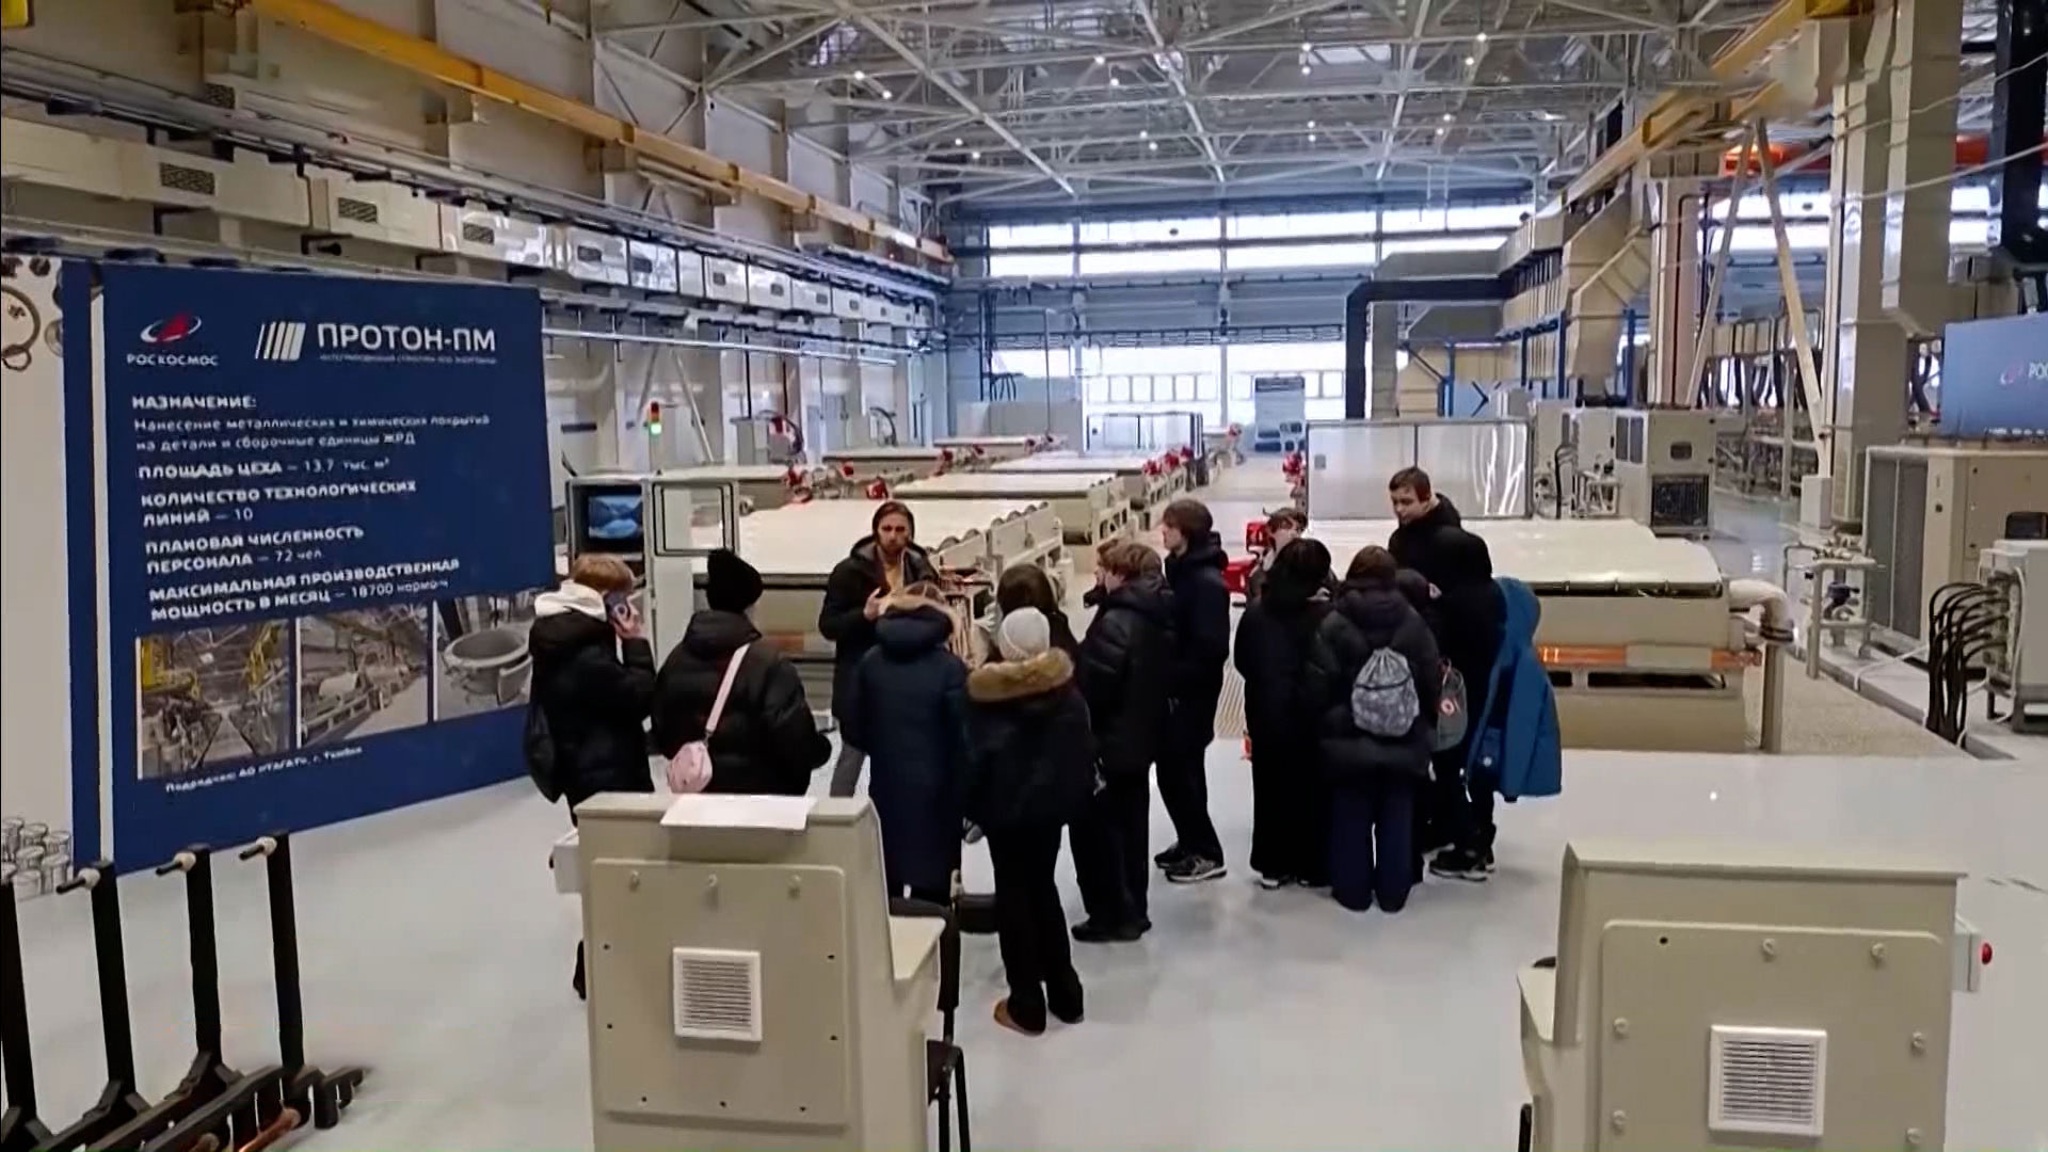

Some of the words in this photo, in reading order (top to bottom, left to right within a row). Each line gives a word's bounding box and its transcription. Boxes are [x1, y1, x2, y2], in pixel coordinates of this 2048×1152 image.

[317, 323, 496, 351] ПРОТОН-ПМ
[127, 353, 219, 366] РОСКОСМОС
[132, 395, 256, 410] НАЗНАЧЕНИЕ:
[134, 418, 221, 432] Нанесение
[226, 417, 335, 430] металлических
[339, 418, 348, 426] и
[352, 416, 428, 427] химических
[430, 414, 490, 429] покрытий
[136, 440, 155, 451] на
[160, 438, 216, 453] детали
[221, 440, 230, 449] и
[235, 435, 314, 450] сборочные
[318, 434, 380, 447] единицы
[383, 431, 416, 445] ЖРД
[138, 463, 234, 479] ПЛОЩАДЬ
[238, 461, 283, 476] ЦЕХА
[140, 488, 260, 508] КОЛИЧЕСТВО
[264, 480, 417, 500] ТЕХНОЛОГИЧЕСКИХ
[143, 507, 211, 527] ЛИНИЙ
[234, 507, 253, 521] 10
[145, 534, 244, 555] ПЛАНОВАЯ
[247, 525, 365, 546] ЧИСЛЕННОСТЬ
[146, 553, 254, 575] ПЕРСОНАЛА
[275, 549, 292, 563] 72
[149, 575, 296, 602] МАКСИМАЛЬНАЯ
[299, 558, 460, 586] ПРОИЗВОДСТВЕННАЯ
[151, 599, 256, 621] МОЩНОСТЬ
[259, 596, 270, 609] В
[274, 589, 331, 607] МЕСЯЦ
[351, 582, 394, 599] 18700
[239, 766, 255, 778] АО
